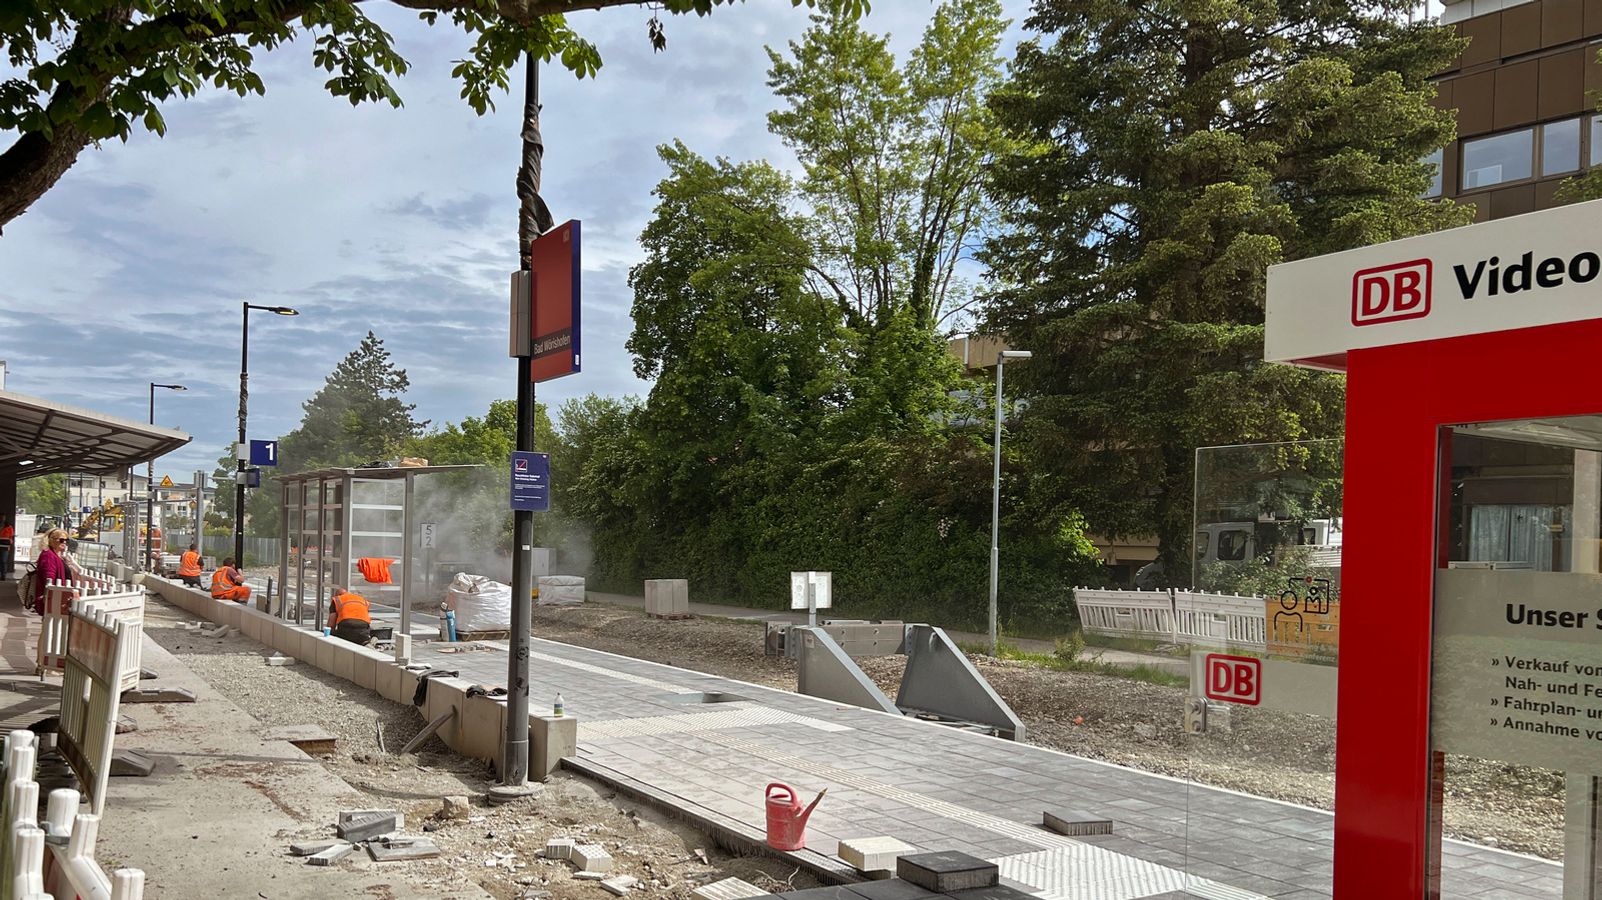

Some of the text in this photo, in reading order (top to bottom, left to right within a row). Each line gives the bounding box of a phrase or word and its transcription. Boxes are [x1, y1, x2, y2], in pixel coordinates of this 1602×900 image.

[1453, 250, 1601, 300] Video
[1361, 269, 1423, 317] DB
[533, 341, 544, 355] Bad
[265, 442, 274, 461] 1
[1506, 603, 1588, 628] Unser
[1505, 655, 1569, 674] Verkauf
[1212, 661, 1255, 697] DB
[1505, 676, 1542, 692] Nah-
[1547, 682, 1578, 696] und
[1503, 696, 1582, 716] Fahrplan-
[1503, 716, 1580, 738] Annahme
